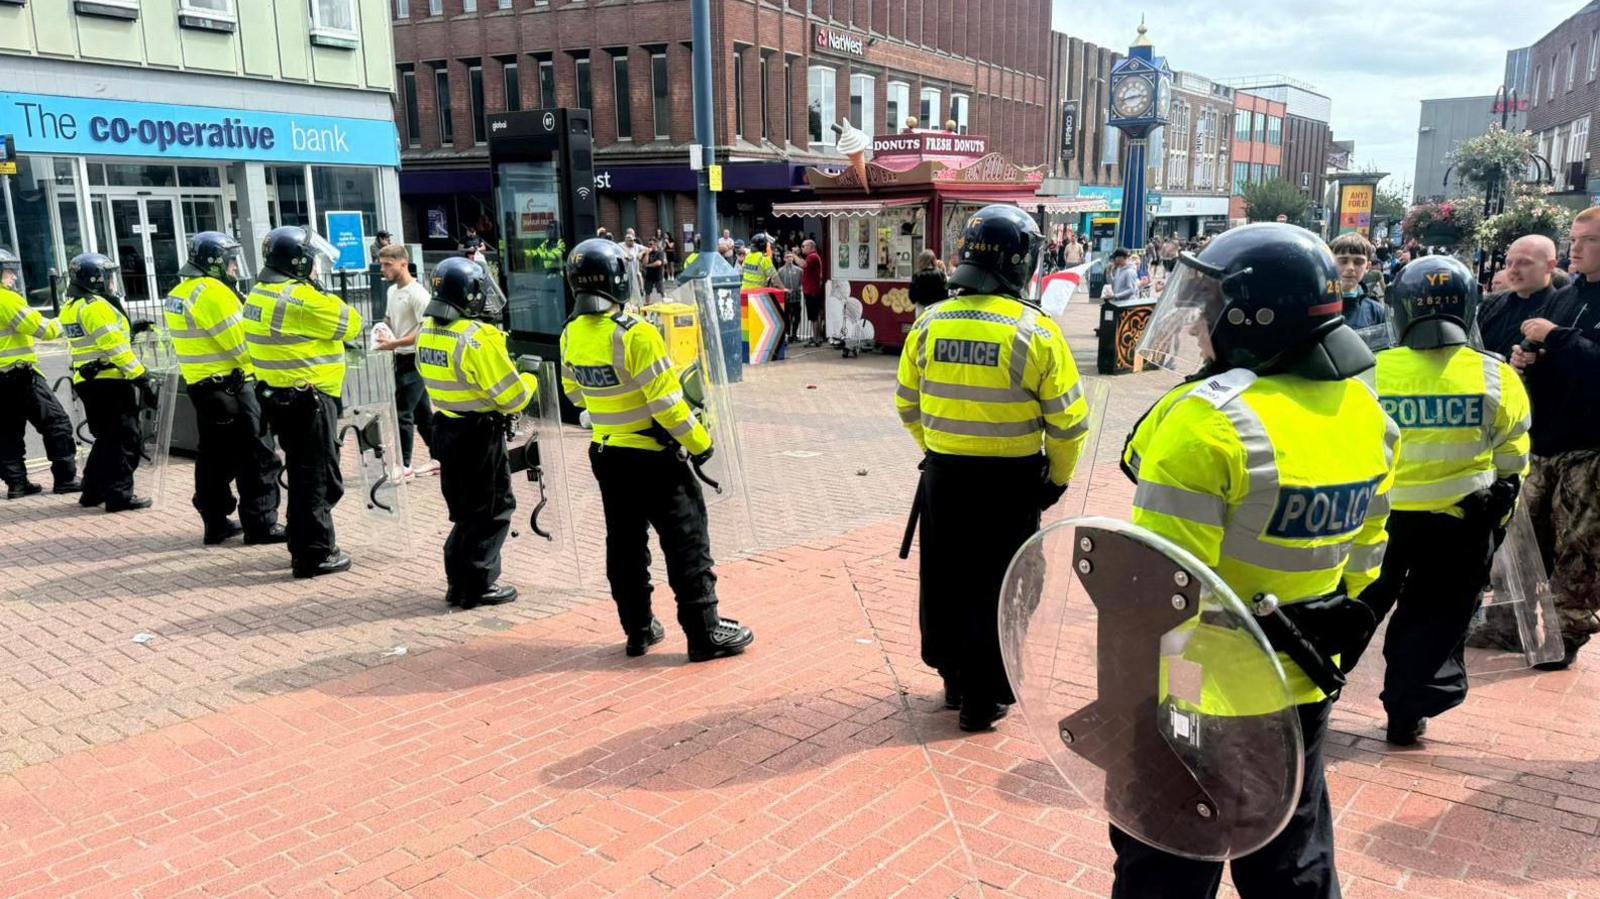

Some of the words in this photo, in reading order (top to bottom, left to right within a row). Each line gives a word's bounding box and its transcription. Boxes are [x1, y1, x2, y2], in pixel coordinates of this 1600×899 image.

[828, 30, 863, 55] NatWest
[15, 102, 77, 140] The
[89, 116, 275, 152] co-operative
[291, 120, 350, 153] bank
[492, 121, 507, 132] global
[545, 117, 552, 126] BT
[874, 139, 920, 151] DONUTS
[926, 137, 952, 151] FRESH
[954, 139, 985, 153] DONUTS
[967, 217, 983, 228] YF
[571, 253, 584, 264] YF
[1425, 272, 1449, 286] YF
[420, 348, 447, 367] POLICE
[937, 340, 998, 365] POLICE
[575, 366, 616, 386] OLICE
[1380, 397, 1481, 425] POLICE
